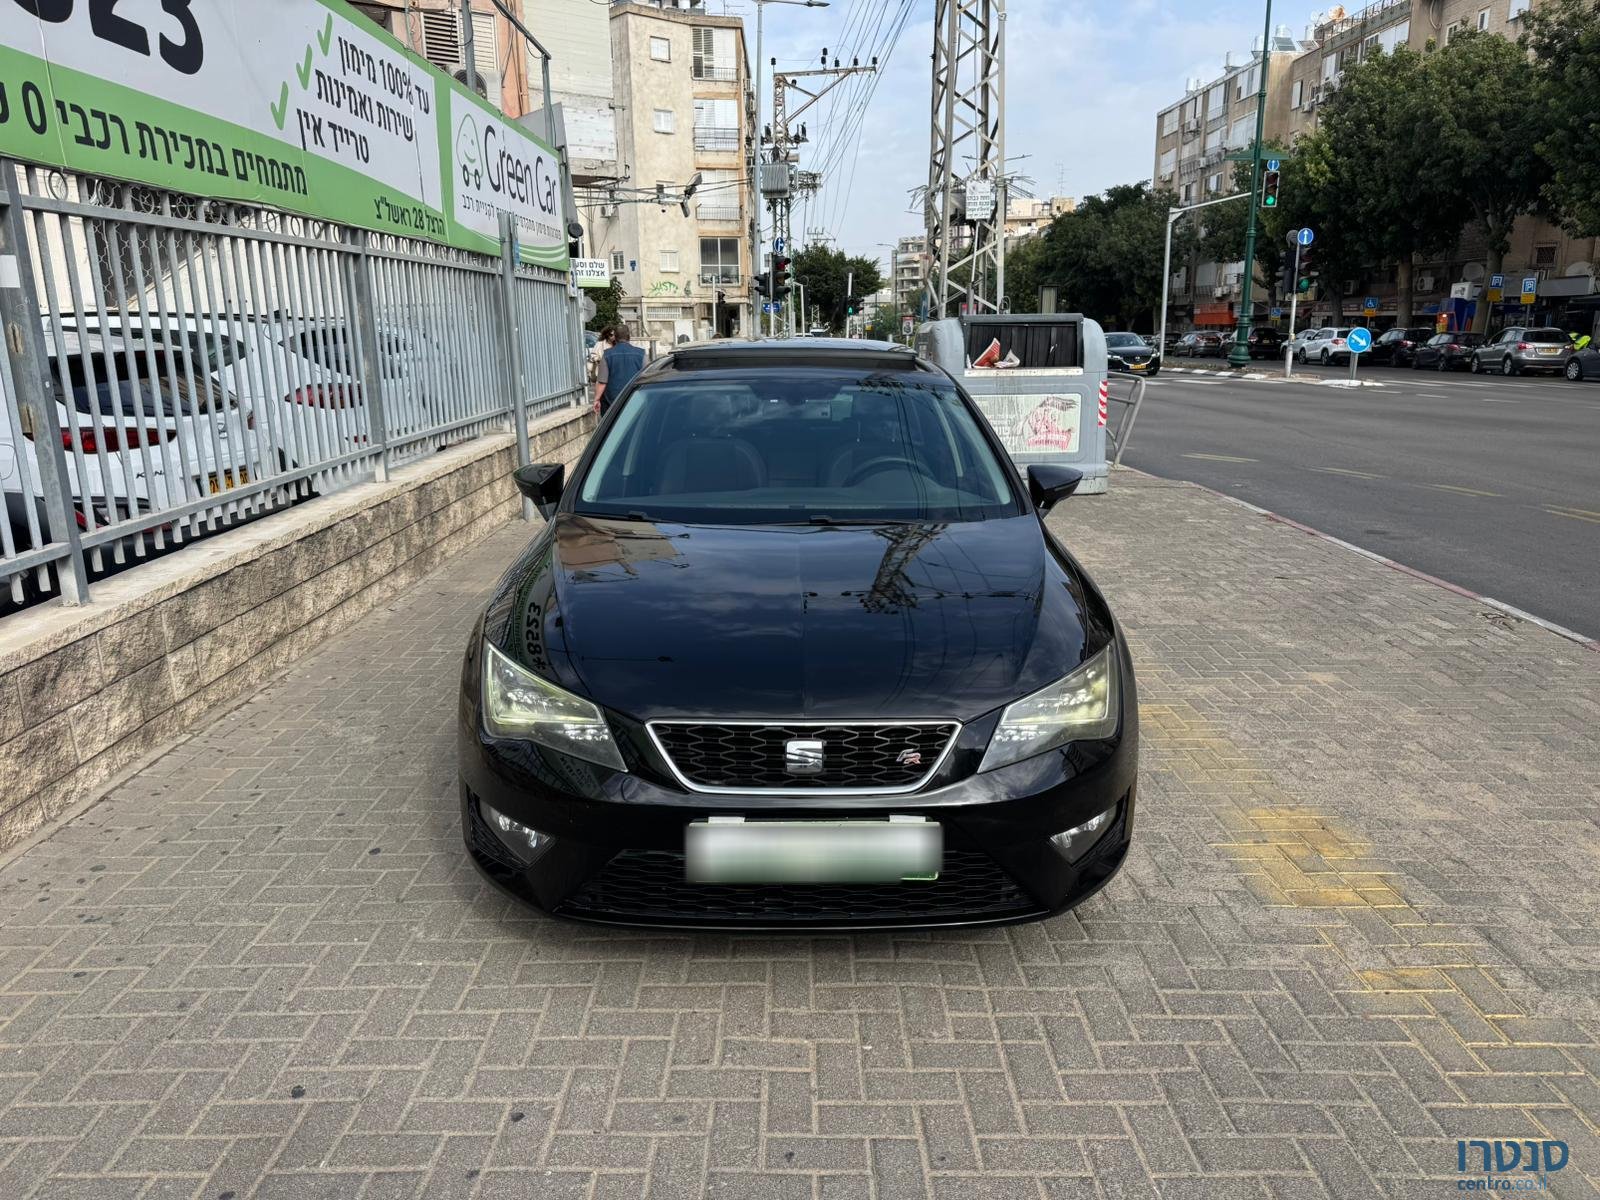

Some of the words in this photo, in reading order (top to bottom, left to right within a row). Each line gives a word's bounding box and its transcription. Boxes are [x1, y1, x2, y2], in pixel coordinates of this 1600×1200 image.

[338, 36, 376, 84] מימון
[380, 59, 413, 105] 100%
[21, 80, 48, 136] 0
[315, 69, 374, 124] ואמינות
[415, 85, 430, 115] עד
[55, 99, 130, 154] רכבי
[296, 108, 325, 151] אין
[328, 121, 369, 164] טרייד
[376, 101, 413, 142] שירות
[135, 121, 229, 177] במכירת
[232, 147, 308, 195] מתמחים
[484, 124, 535, 208] Green
[535, 155, 557, 217] Car
[412, 206, 425, 231] 28
[424, 209, 446, 236] הרצל
[462, 194, 475, 212] רכב
